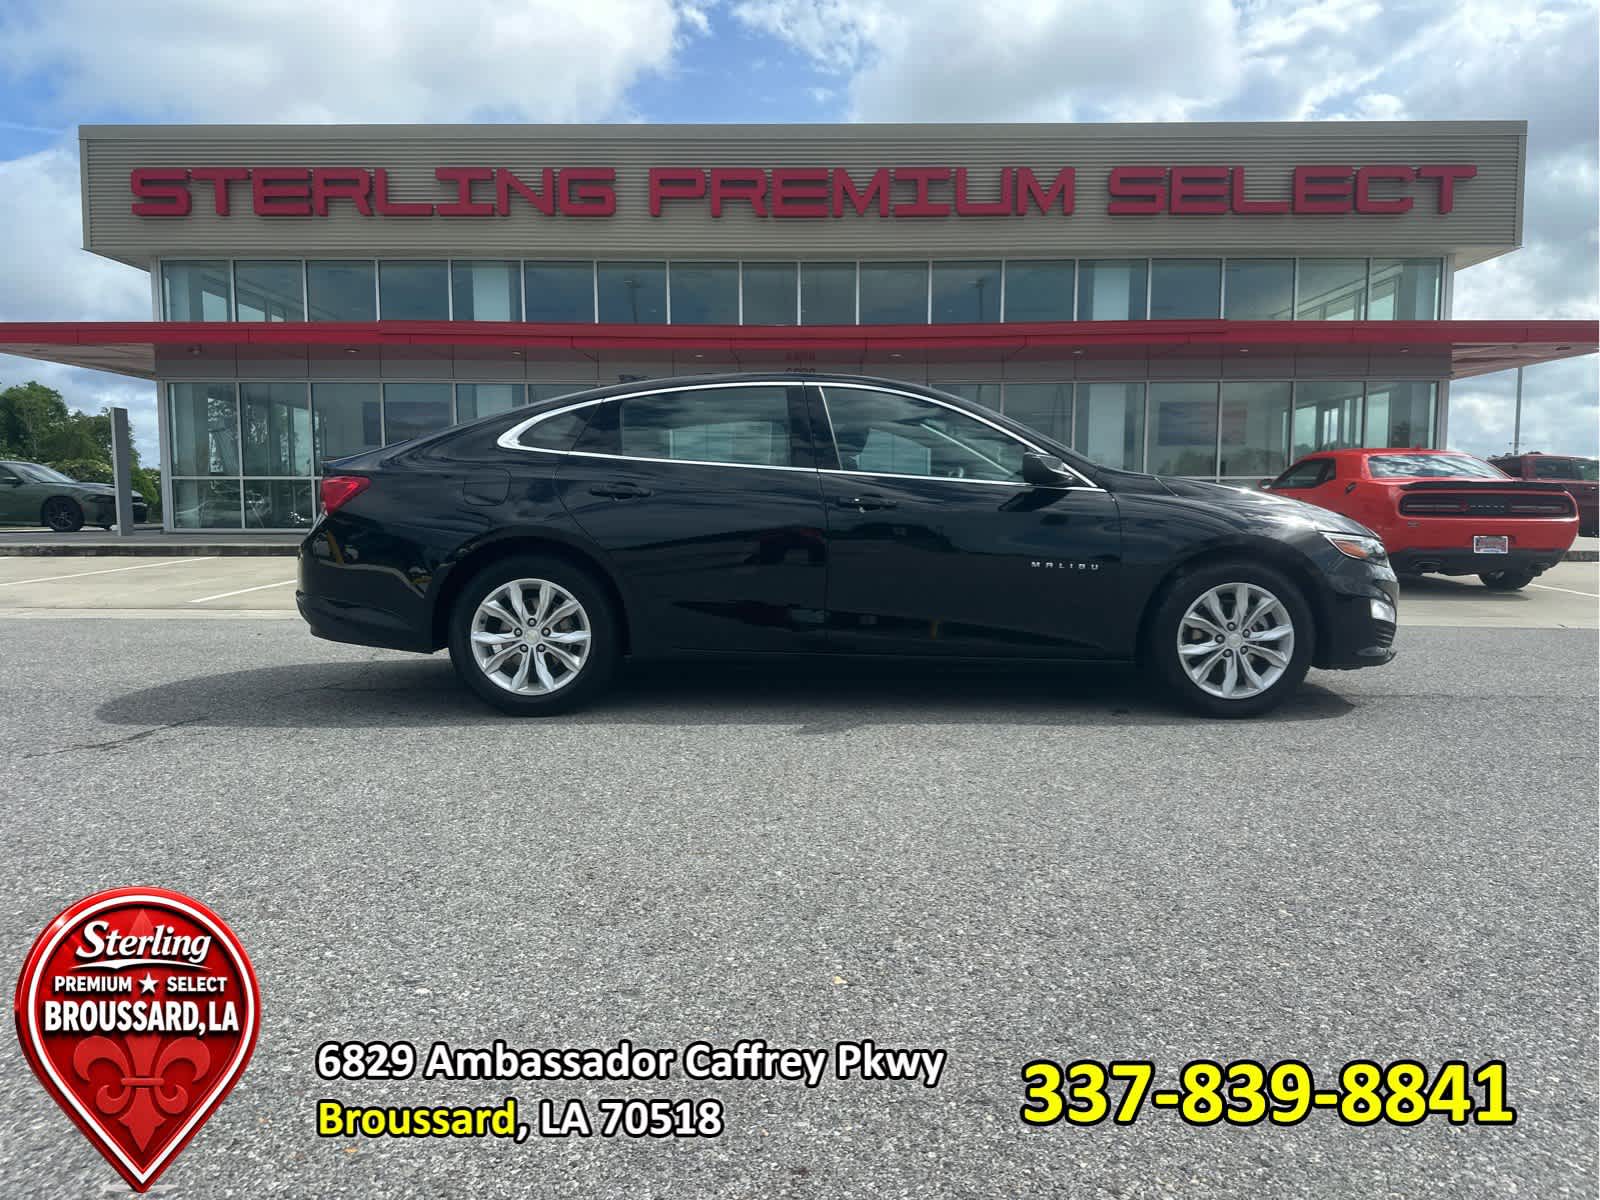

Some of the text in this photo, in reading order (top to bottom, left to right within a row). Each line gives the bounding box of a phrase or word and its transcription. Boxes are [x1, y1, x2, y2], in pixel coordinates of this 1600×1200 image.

[131, 166, 1477, 217] STERLING PREMIUM SELECT
[1030, 561, 1100, 571] MALIBU
